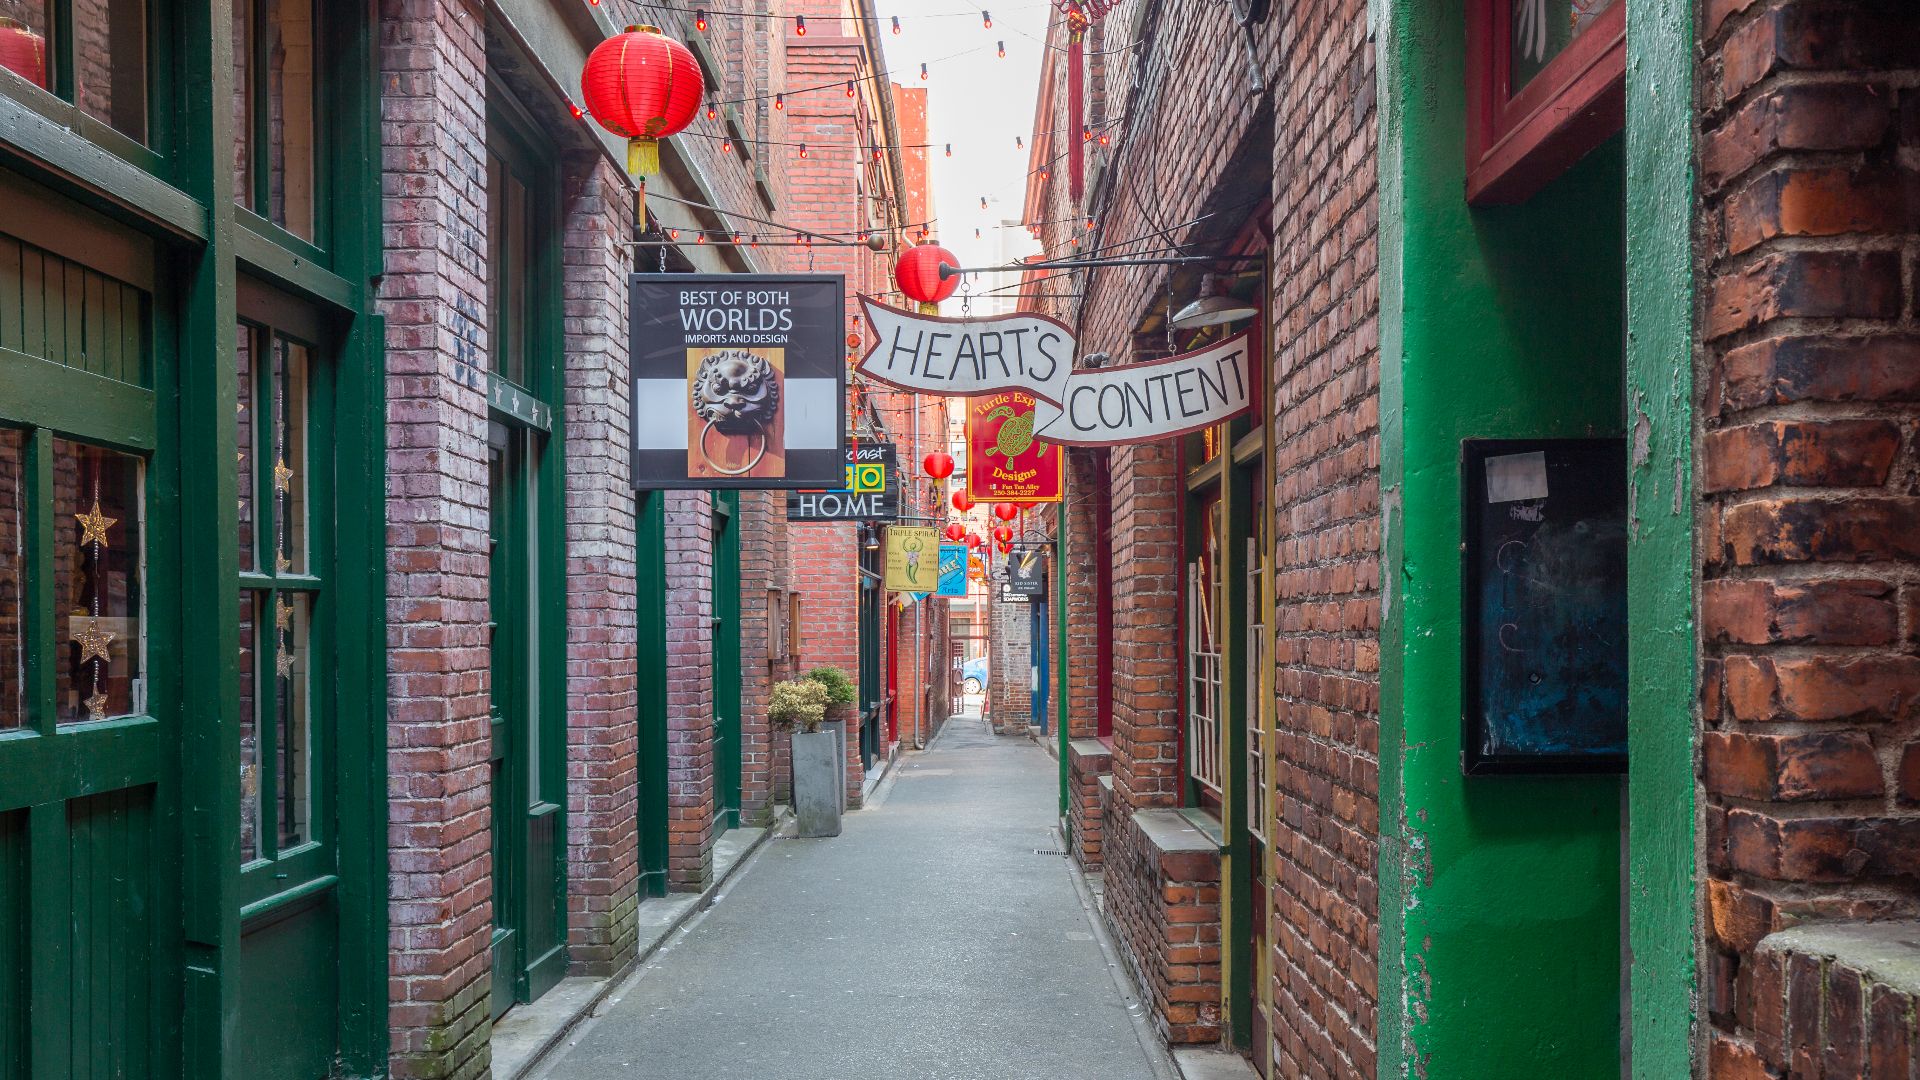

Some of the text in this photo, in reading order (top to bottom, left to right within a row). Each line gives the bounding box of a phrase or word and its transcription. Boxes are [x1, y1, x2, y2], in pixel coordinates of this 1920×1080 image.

[680, 291, 789, 305] BEST OF BOTH
[680, 308, 793, 331] WORLDS
[685, 334, 788, 343] IMPORTS AND DESIGN
[887, 325, 1060, 382] HEART'S
[1070, 349, 1244, 431] CONTENT
[975, 393, 1036, 415] Turtle Exp
[992, 467, 1037, 483] Designs
[800, 494, 884, 517] HOME
[890, 529, 938, 538] TRIPLE SPIRAL
